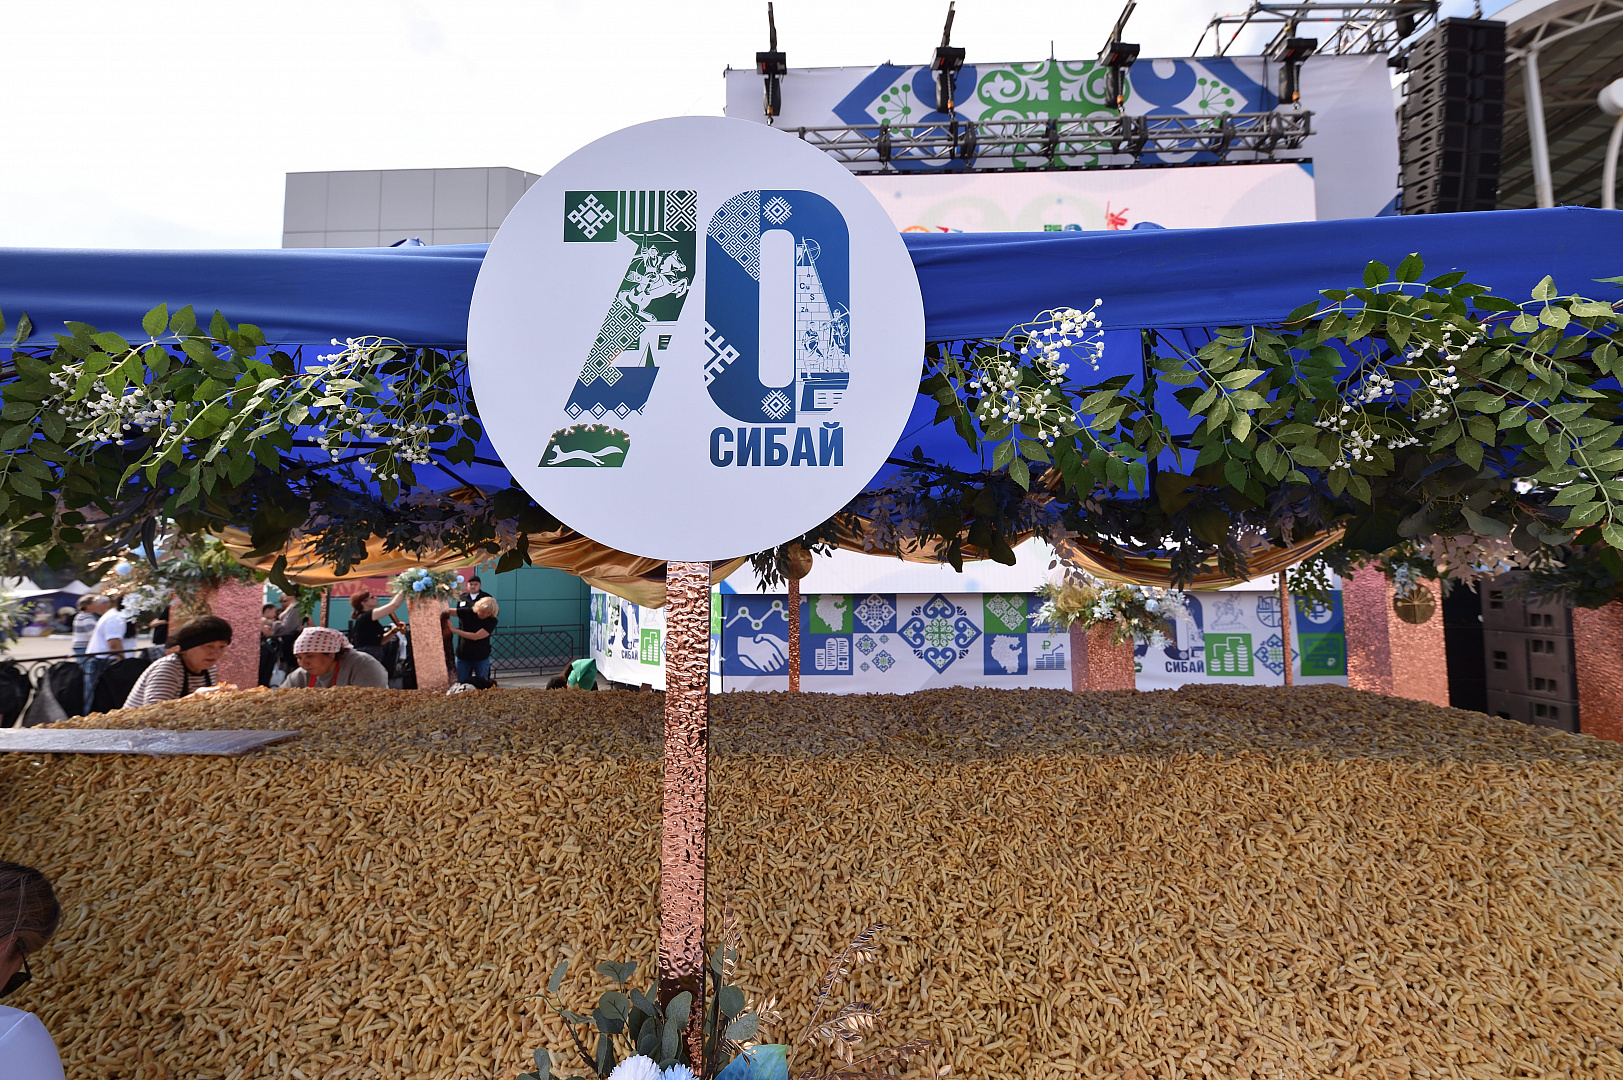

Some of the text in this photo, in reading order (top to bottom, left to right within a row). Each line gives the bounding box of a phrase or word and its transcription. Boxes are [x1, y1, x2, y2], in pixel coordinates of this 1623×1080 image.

[799, 282, 811, 290] Cu
[809, 293, 815, 301] S
[538, 190, 850, 467] 70
[709, 421, 844, 468] СИБАЙ
[1165, 660, 1205, 673] СИБАЙ
